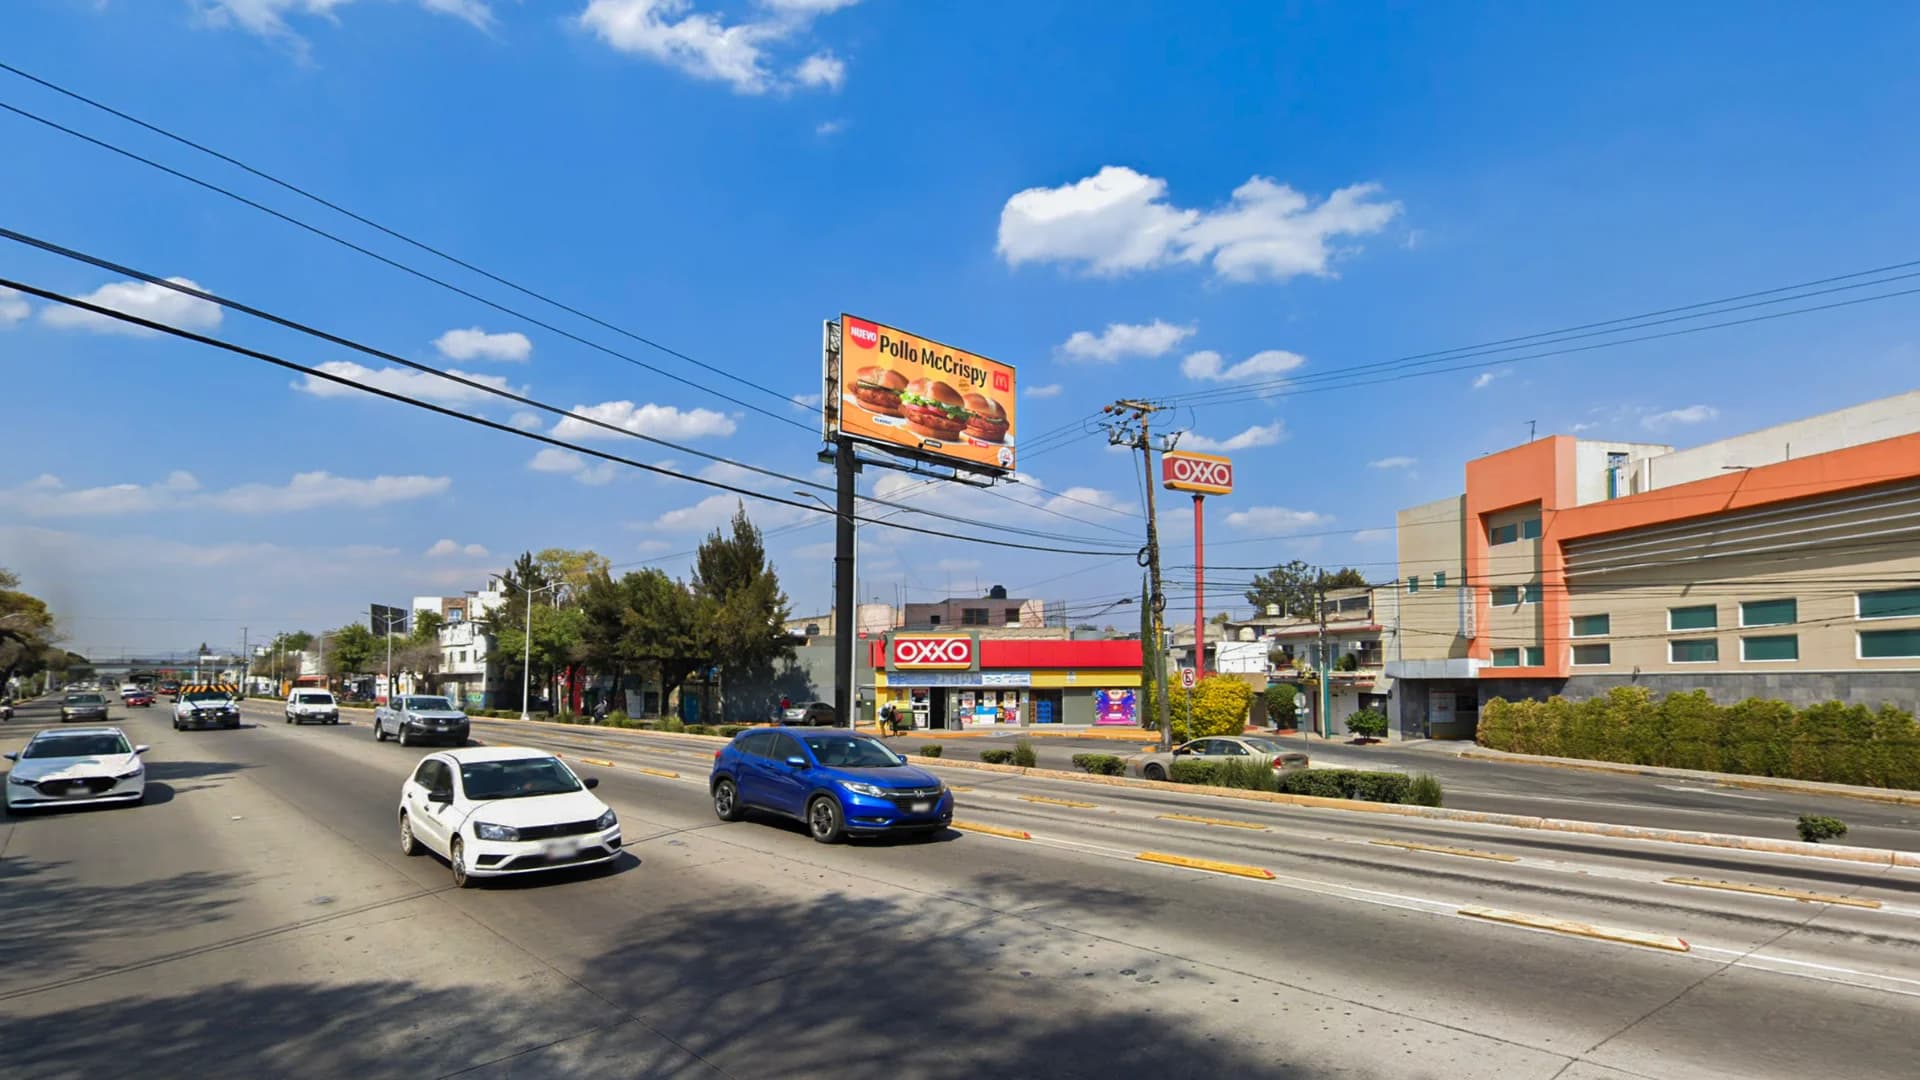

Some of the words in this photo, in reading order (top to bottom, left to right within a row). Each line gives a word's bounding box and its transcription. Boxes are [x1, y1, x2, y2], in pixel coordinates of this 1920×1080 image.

[851, 326, 877, 342] NUEVO
[880, 335, 918, 362] Pollo
[921, 347, 987, 388] McCrispy
[1174, 460, 1229, 484] OXXO
[897, 638, 968, 663] OXXO
